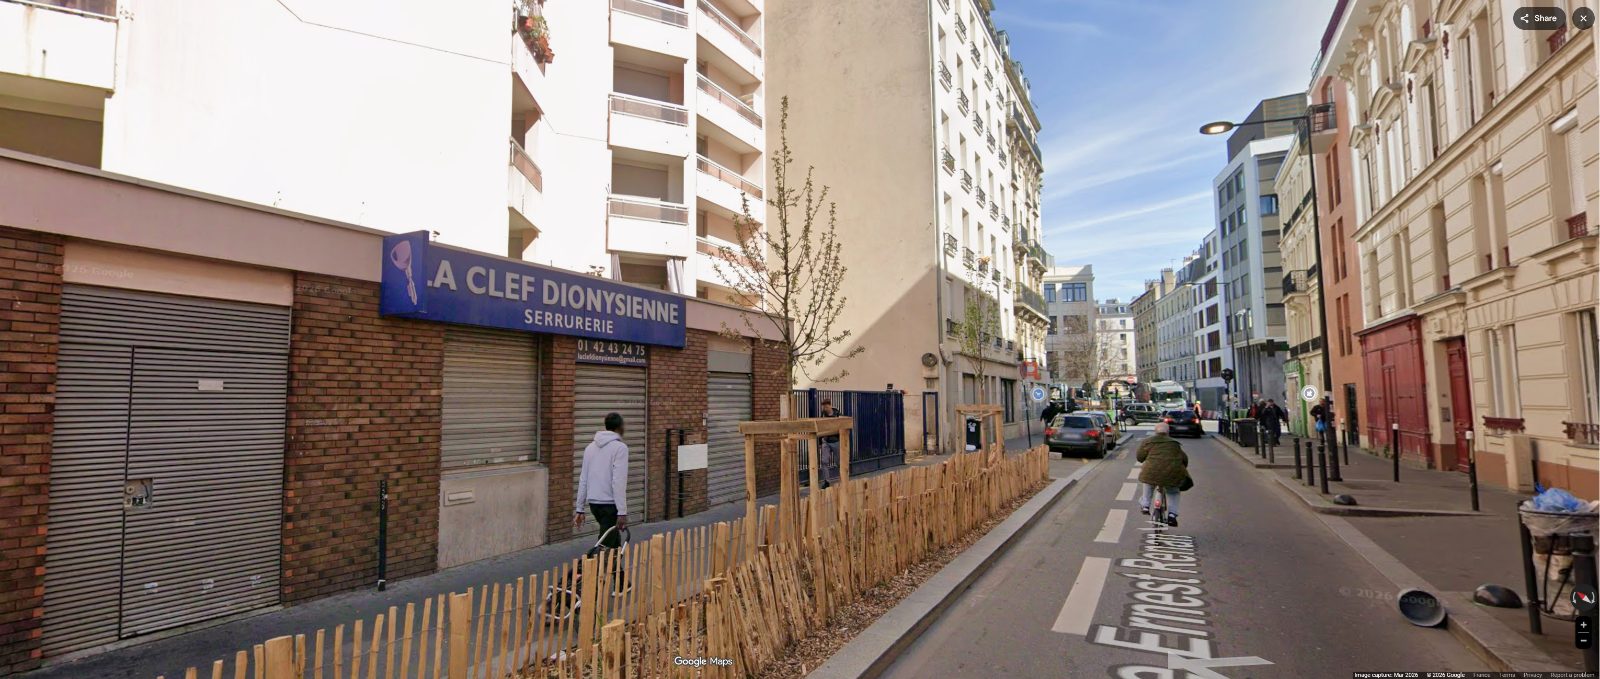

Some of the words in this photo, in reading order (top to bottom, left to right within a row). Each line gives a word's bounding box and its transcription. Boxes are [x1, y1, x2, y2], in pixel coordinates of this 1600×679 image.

[466, 266, 535, 301] CLEF
[543, 279, 679, 325] DIONYSIENNE
[524, 309, 614, 334] SERRURERIE
[577, 338, 588, 351] 01
[592, 341, 604, 353] 42
[607, 342, 618, 354] 43
[622, 343, 632, 355] 24
[635, 344, 645, 356] 75
